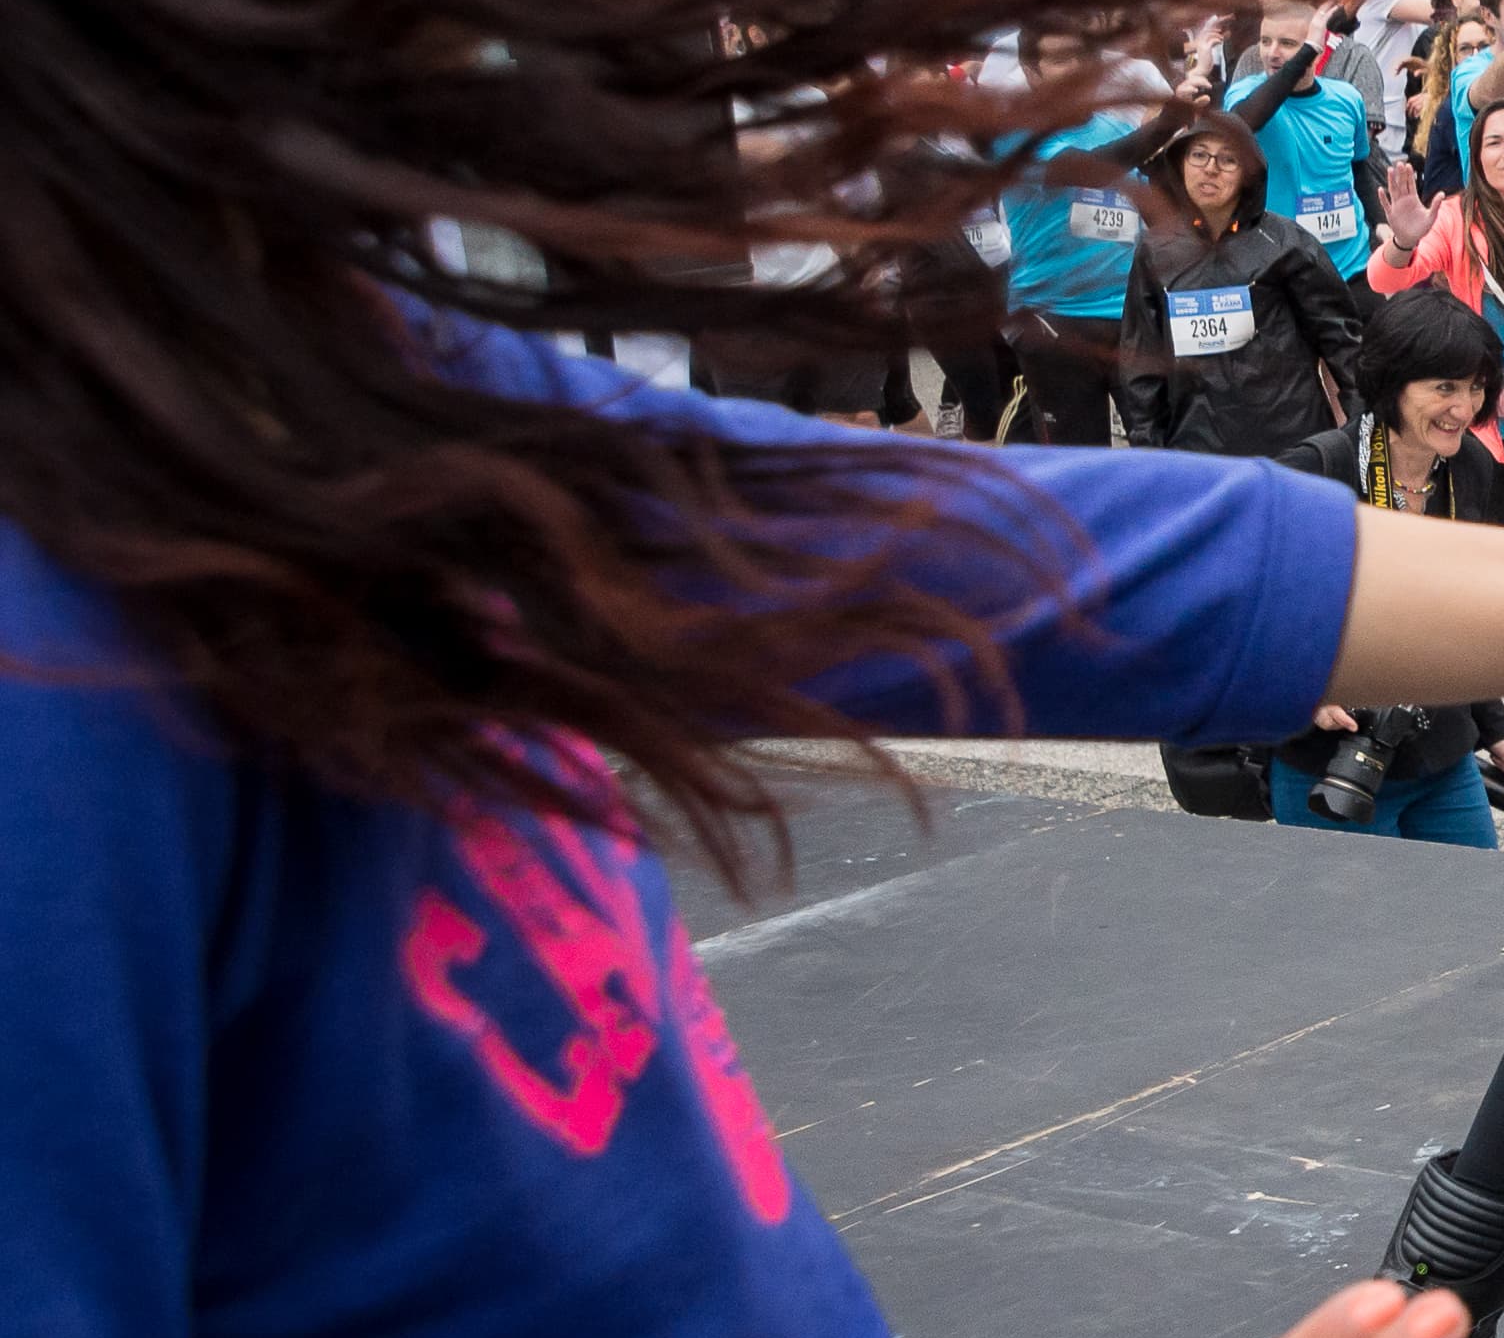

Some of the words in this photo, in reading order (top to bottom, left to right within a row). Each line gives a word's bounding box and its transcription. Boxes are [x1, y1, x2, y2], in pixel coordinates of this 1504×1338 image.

[1093, 208, 1124, 227] 4239
[1317, 213, 1341, 230] 1474
[1190, 317, 1227, 338] 2364
[1373, 466, 1387, 509] Nikon
